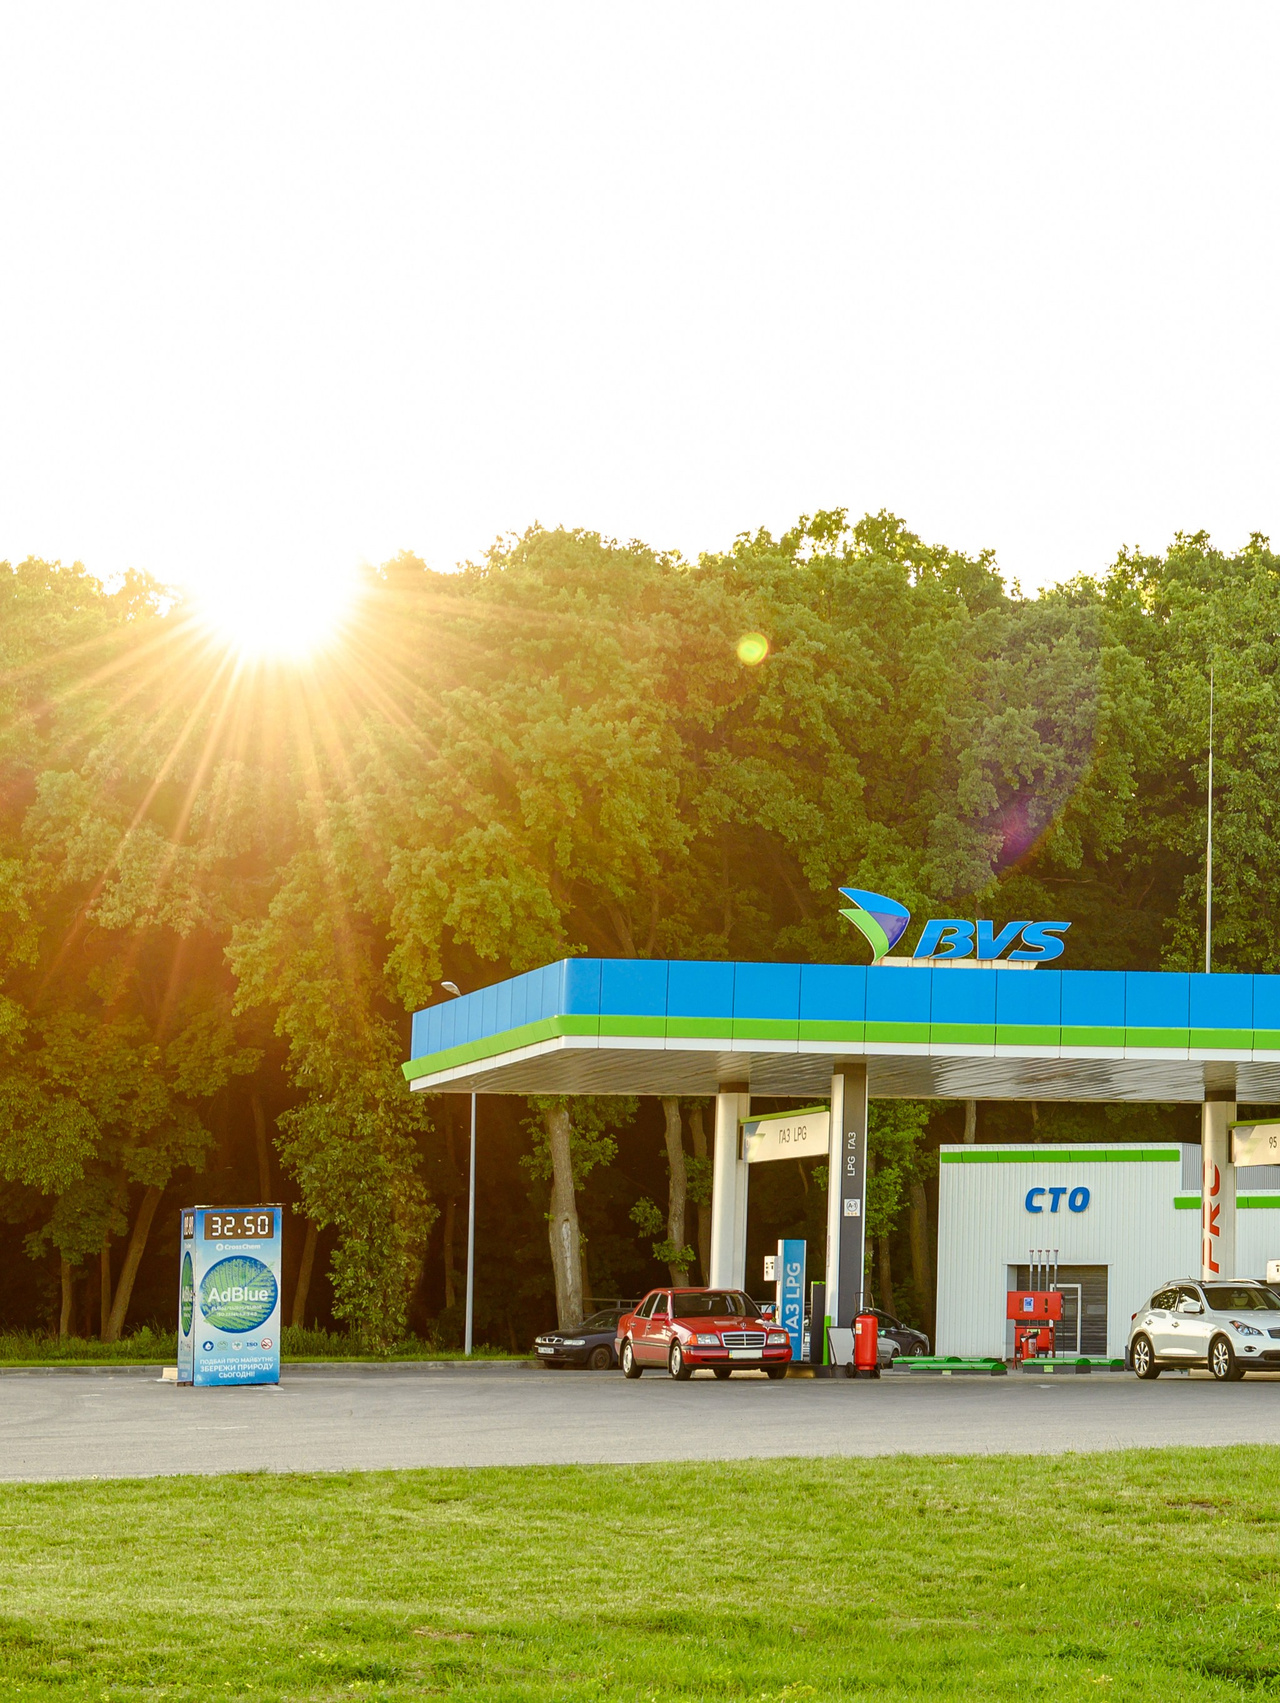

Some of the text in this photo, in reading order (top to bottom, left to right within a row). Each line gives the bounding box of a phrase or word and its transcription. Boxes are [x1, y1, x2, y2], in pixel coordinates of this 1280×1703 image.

[912, 919, 1072, 961] BVS
[779, 1125, 807, 1144] ГАЗ LPG
[1268, 1136, 1277, 1148] 95
[847, 1131, 857, 1176] LPG ГАЗ
[1025, 1187, 1091, 1213] СТО
[212, 1215, 269, 1236] 32.50
[786, 1262, 801, 1298] LPG
[208, 1286, 269, 1303] AdBlue
[237, 1363, 274, 1371] ПРИРОДУ
